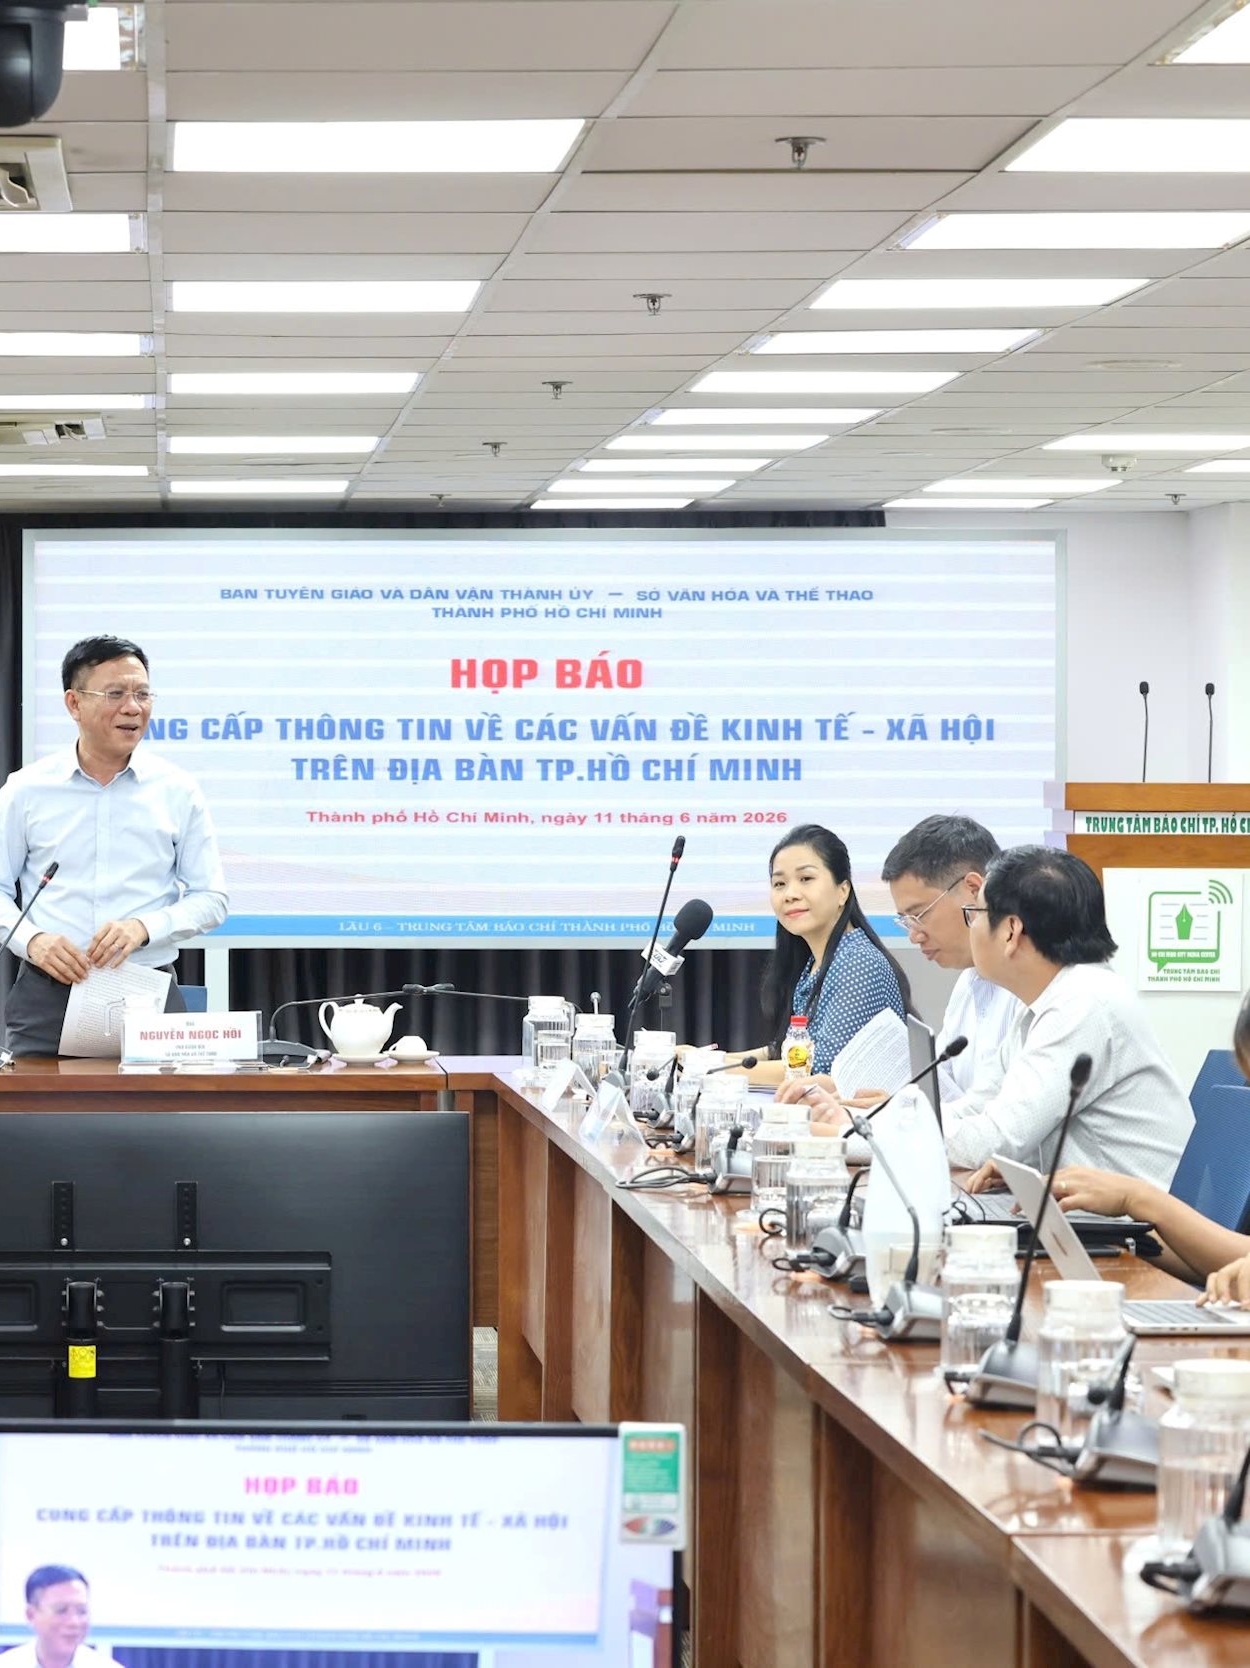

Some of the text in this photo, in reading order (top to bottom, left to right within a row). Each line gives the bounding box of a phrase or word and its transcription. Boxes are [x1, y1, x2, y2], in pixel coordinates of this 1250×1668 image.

[220, 588, 258, 600] BAN
[264, 586, 324, 600] TUYÊN
[331, 586, 373, 600] GIÁO
[380, 586, 404, 600] VÀ
[410, 586, 449, 600] DÂN
[455, 586, 493, 601] VẬN
[500, 586, 562, 600] THÀNH
[637, 587, 660, 601] SỞ
[668, 588, 705, 601] VĂN
[712, 587, 750, 601] HÓA
[756, 587, 780, 601] VÀ
[785, 586, 820, 601] THỂ
[825, 589, 874, 601] THAO
[431, 603, 661, 618] THÀNH PHỐ HỒ CHÍ MINH
[452, 651, 642, 694] HỌP BÁO
[144, 718, 188, 741] NG
[202, 711, 263, 741] CẤP
[275, 713, 384, 741] THÔNG
[397, 719, 451, 741] TIN
[465, 711, 503, 741] VỀ
[516, 712, 577, 741] CÁC
[590, 711, 656, 741] VẤN
[670, 711, 709, 741] ĐỀ
[722, 719, 803, 741] KINH
[815, 712, 856, 741] TẾ
[887, 714, 928, 741] XÃ
[941, 714, 994, 745] HỘI
[291, 752, 801, 785] TRÊN ĐỊA BÀN TP.HỒ CHÍ MINH
[306, 809, 787, 826] Thành phố Hồ Chí Minh, ngày 11 tháng 6 năm 2026
[1086, 816, 1124, 832] TRUNG
[1126, 813, 1150, 832] TÂM
[1154, 813, 1178, 832] BÁO
[1180, 813, 1200, 832] CHÍ
[1202, 816, 1218, 832] TP.
[1221, 812, 1237, 832] HỒ
[372, 921, 383, 932] 6
[398, 922, 452, 932] TRUNG
[456, 920, 488, 932] TÂM
[493, 920, 525, 932] BÁO
[528, 920, 556, 932] CHÍ
[560, 920, 615, 932] THÀNH
[713, 922, 756, 932] MINH
[140, 1028, 184, 1041] NGUYỄN
[189, 1029, 219, 1042] NGỌC
[245, 1475, 359, 1498] HỌP BÁO
[36, 1508, 90, 1522] CUNG
[96, 1506, 134, 1523] CẤP
[142, 1508, 205, 1525] THÔNG
[213, 1511, 245, 1526] TIN
[281, 1510, 318, 1527] CÁC
[403, 1514, 452, 1529] KINH
[534, 1513, 568, 1532] HỘI
[151, 1531, 199, 1548] TRÊN
[355, 1534, 388, 1552] CHÍ
[395, 1537, 451, 1553] MINH
